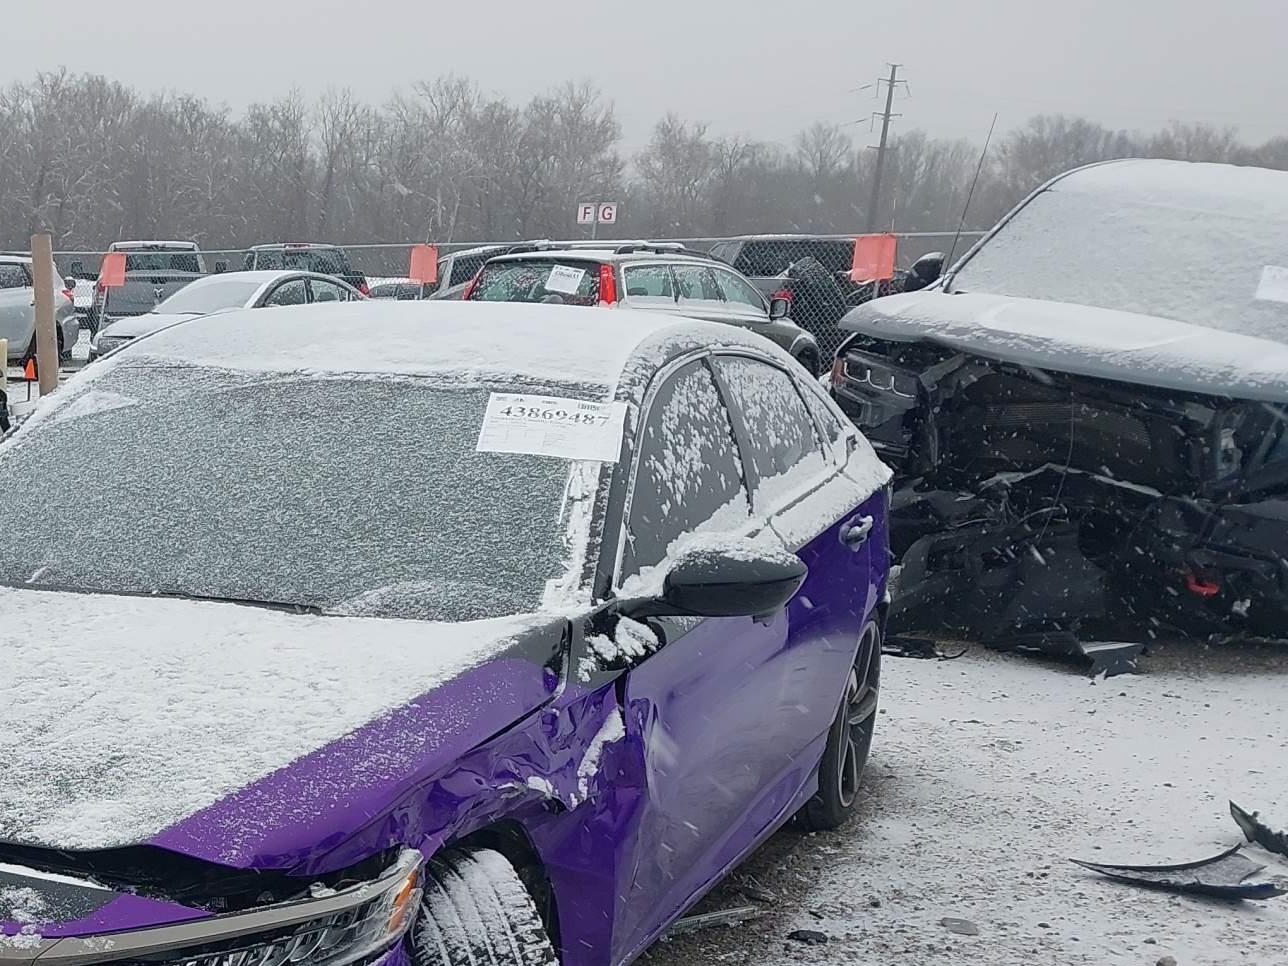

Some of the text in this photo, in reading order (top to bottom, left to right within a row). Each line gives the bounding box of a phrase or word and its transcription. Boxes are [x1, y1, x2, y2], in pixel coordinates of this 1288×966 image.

[583, 206, 592, 221] F
[601, 206, 613, 221] G
[500, 405, 611, 427] 43869487
